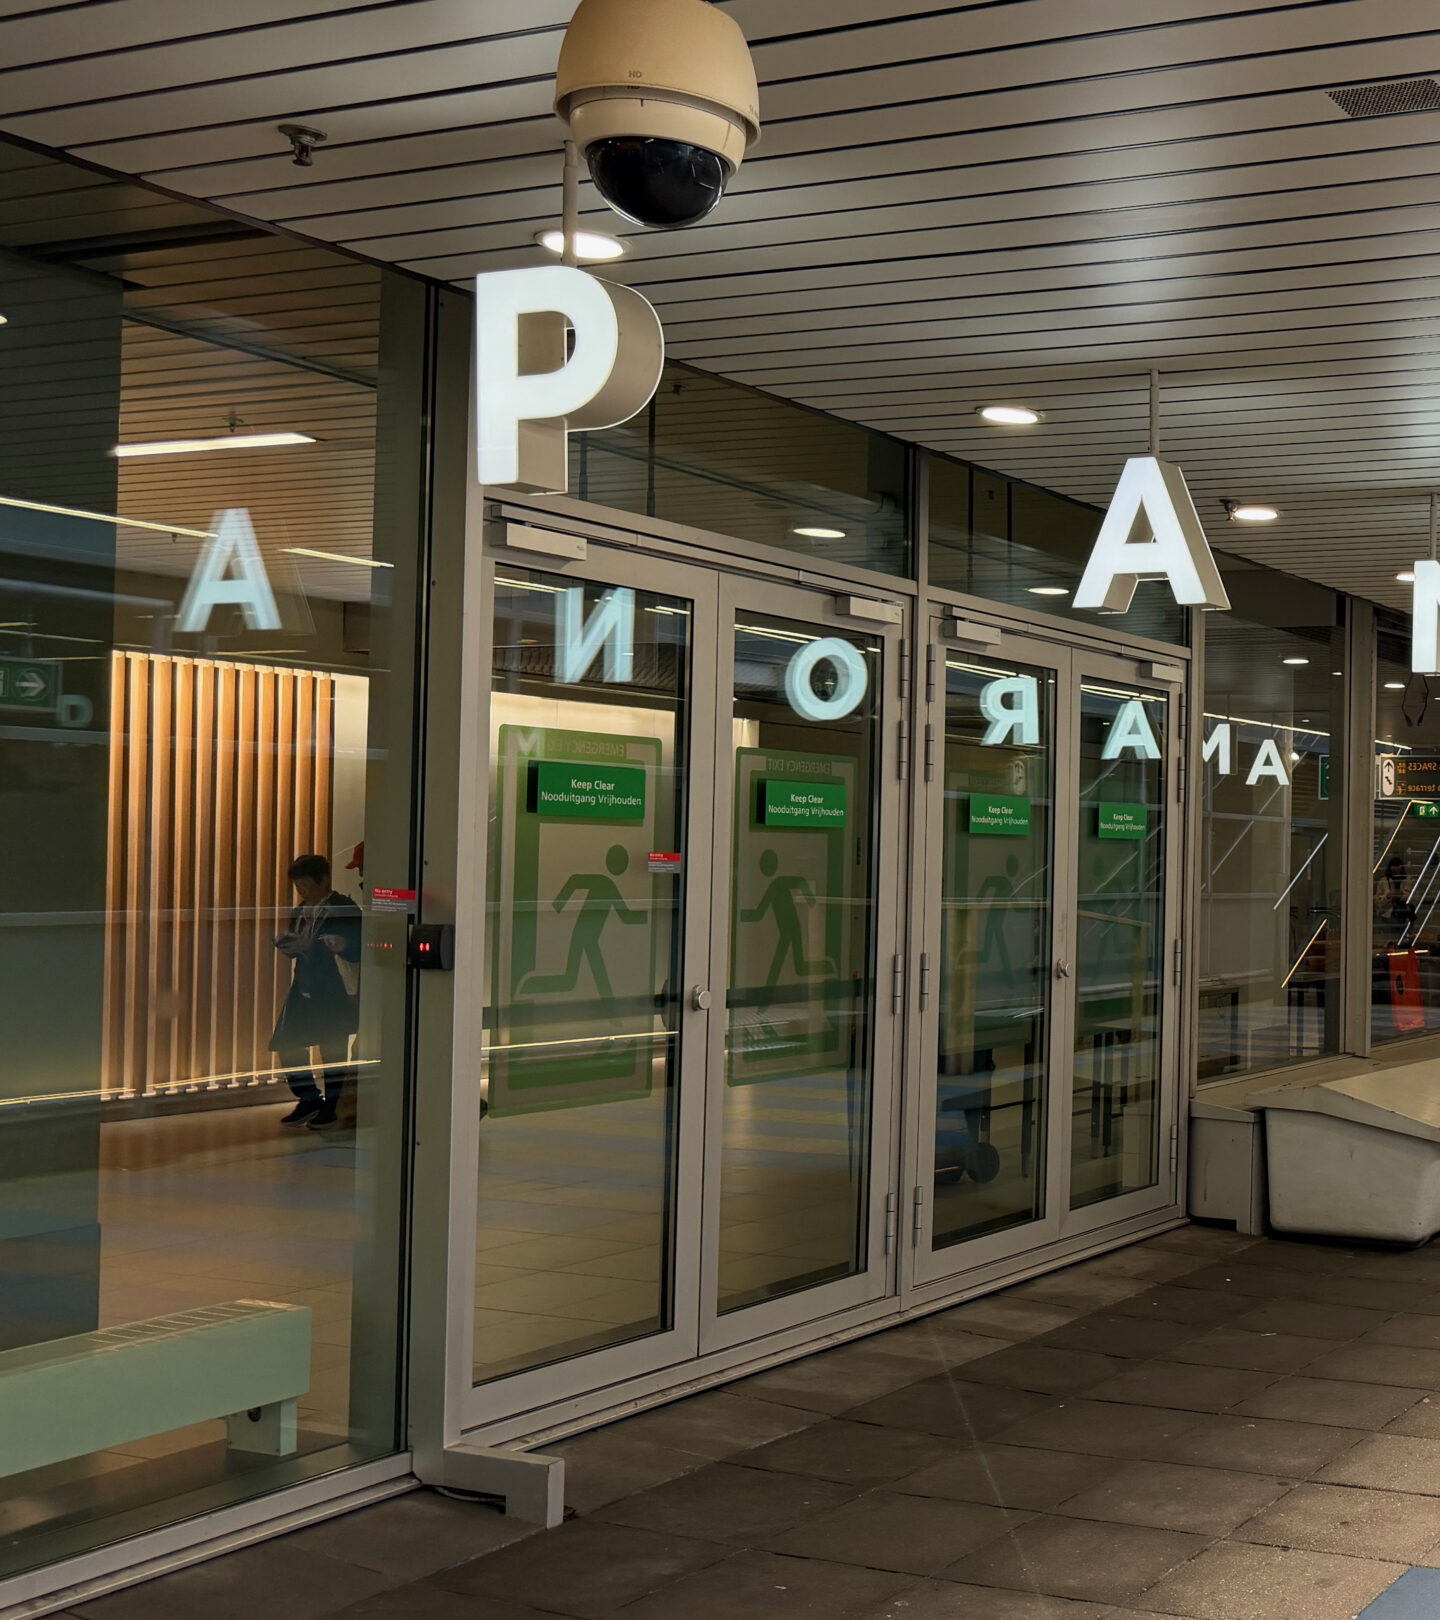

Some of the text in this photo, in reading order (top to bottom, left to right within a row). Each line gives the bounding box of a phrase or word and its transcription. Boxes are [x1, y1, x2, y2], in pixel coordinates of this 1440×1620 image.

[628, 70, 642, 79] HD
[571, 779, 615, 791] Keep Clear
[541, 791, 642, 806] Nooduitgang Vrijhouden
[790, 794, 824, 804] Keep Clear
[768, 804, 844, 817] Nooduitgang Vrijhouden
